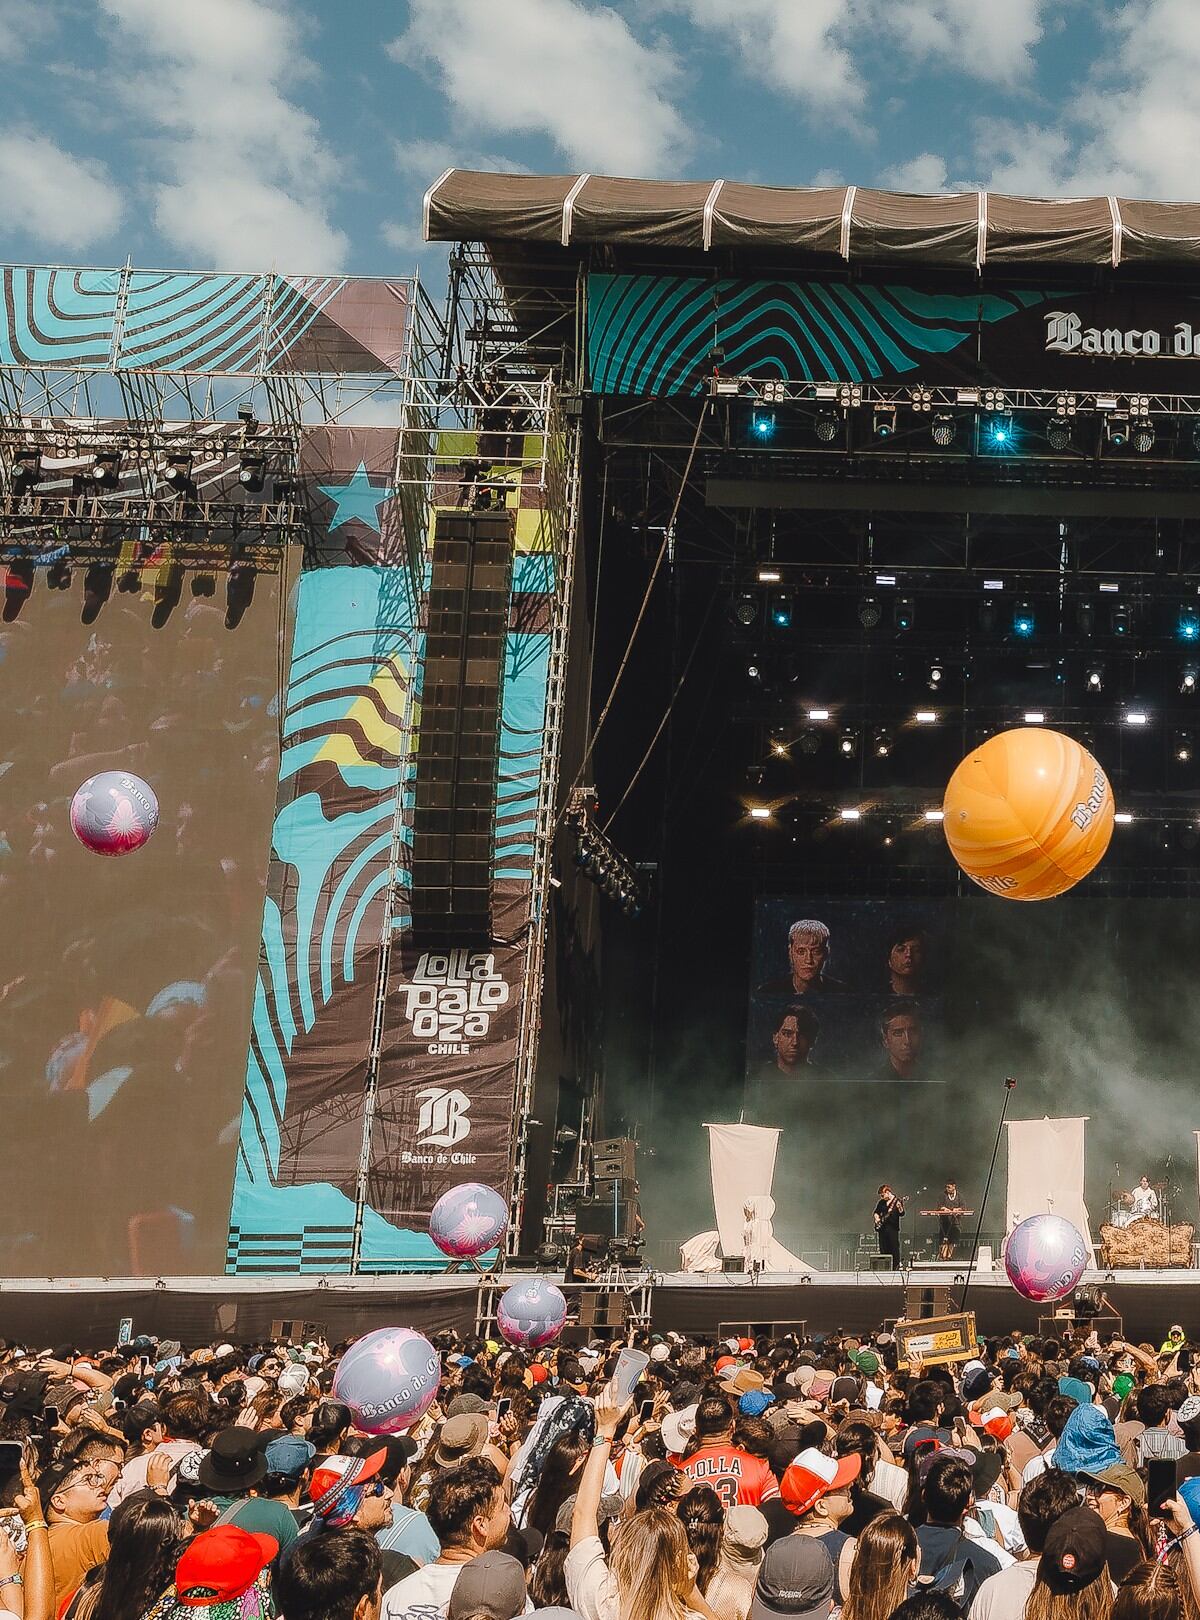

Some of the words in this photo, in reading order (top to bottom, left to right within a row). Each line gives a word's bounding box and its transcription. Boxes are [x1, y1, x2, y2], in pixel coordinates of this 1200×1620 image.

[1044, 311, 1161, 355] Banco
[120, 779, 151, 811] Banco
[427, 1043, 470, 1056] CHILE
[401, 1151, 434, 1165] Banco
[436, 1153, 449, 1165] de
[451, 1152, 477, 1166] Chile
[359, 1387, 412, 1418] Banco
[411, 1374, 428, 1391] de
[683, 1455, 743, 1481] LOLLA
